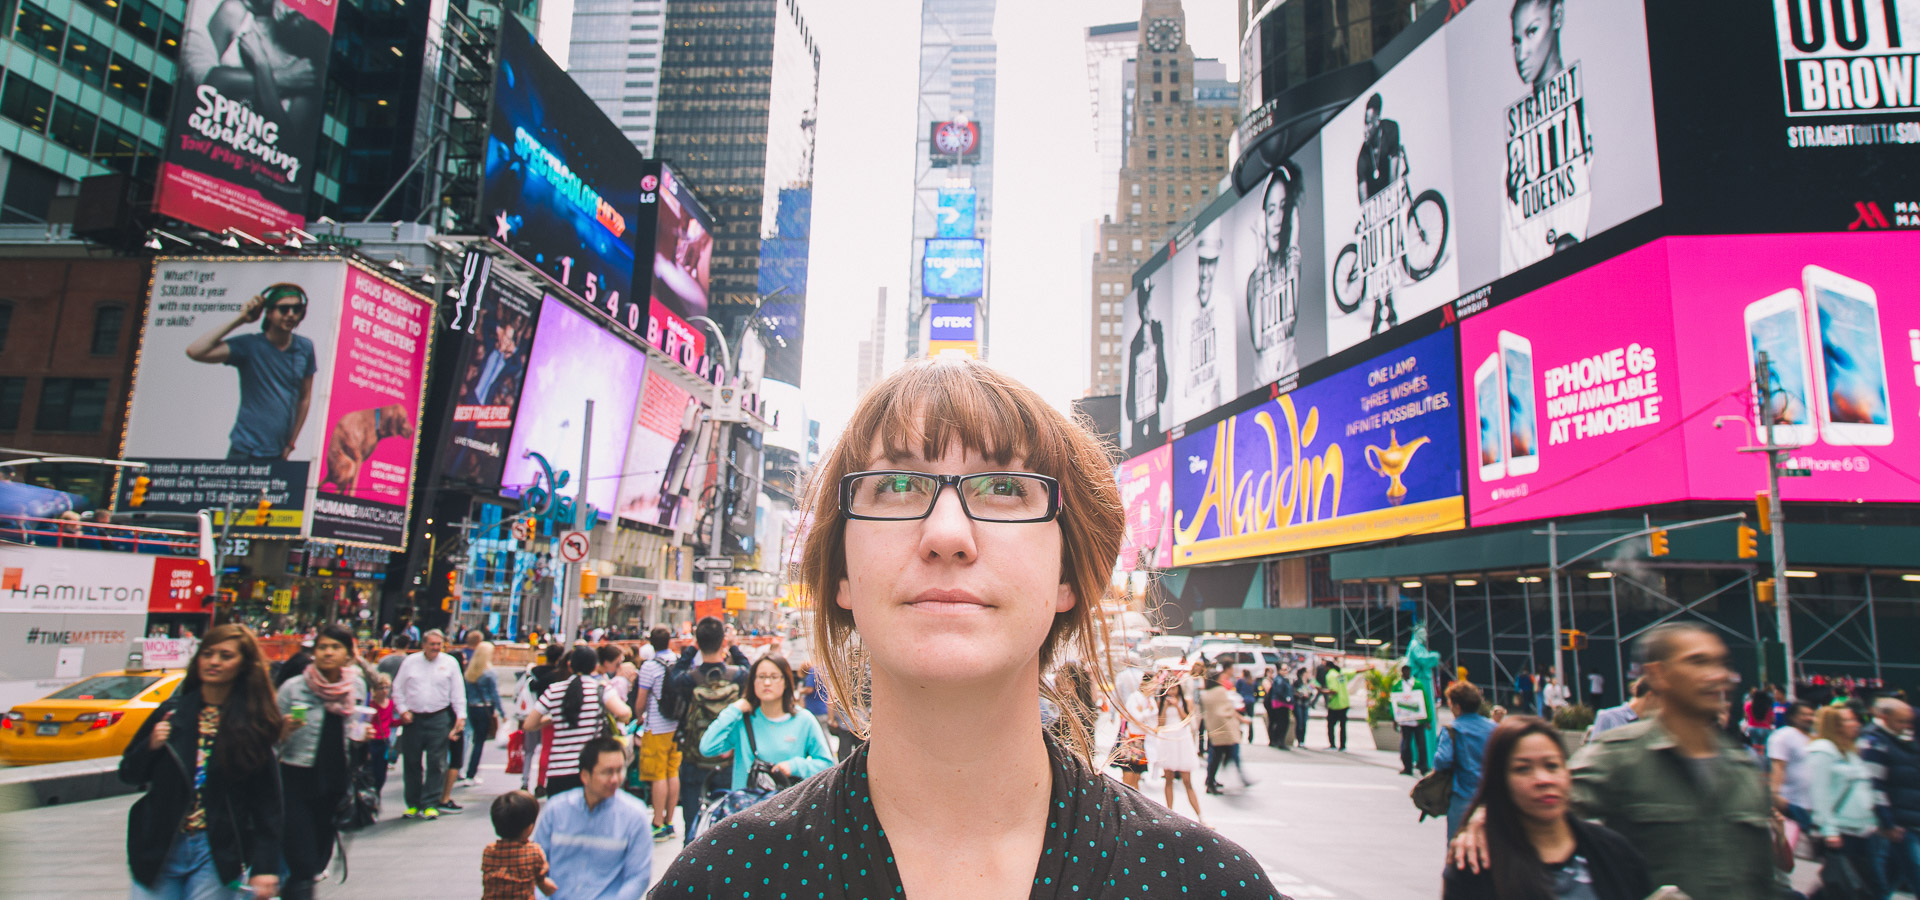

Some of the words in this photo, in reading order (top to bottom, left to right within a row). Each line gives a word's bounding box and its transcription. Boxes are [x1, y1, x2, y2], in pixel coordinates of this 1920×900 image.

[1508, 66, 1577, 138] STRAIGHT
[196, 84, 279, 145] SPRING
[188, 113, 301, 183] awakening
[640, 192, 657, 204] LG
[1522, 164, 1576, 220] QUEENS
[926, 257, 982, 269] TOSHIBA
[164, 270, 194, 282] What?
[199, 271, 215, 284] get
[161, 285, 198, 297] $30,000
[207, 287, 228, 299] year
[355, 274, 382, 300] HSUS
[158, 301, 177, 312] with
[179, 304, 191, 312] no
[192, 303, 243, 314] experience
[351, 294, 377, 318] GIVE
[376, 305, 408, 331] SQUAT
[408, 321, 422, 337] TO
[155, 317, 165, 327] or
[166, 315, 195, 327] skills?
[944, 316, 973, 329] TDK
[352, 315, 373, 336] PET
[372, 324, 417, 354] SHELTERS
[1368, 367, 1389, 387] ONE
[1361, 389, 1390, 412] THREE
[1547, 392, 1579, 420] NOW
[1578, 372, 1658, 408] AVAILABLE
[454, 405, 474, 421] BEST
[473, 405, 491, 421] TIME
[1345, 413, 1382, 437] INFINITE
[1549, 418, 1571, 446] AT
[151, 463, 178, 474] needs
[180, 466, 191, 474] an
[192, 463, 237, 475] education
[238, 466, 249, 475] or
[250, 464, 271, 476] hard
[1174, 394, 1344, 546] Aladdin
[1800, 456, 1842, 472] iPhone
[152, 478, 175, 489] when
[229, 478, 238, 488] is
[239, 479, 270, 492] raising
[272, 479, 287, 491] the
[167, 492, 191, 504] wage
[193, 492, 205, 502] to
[206, 492, 215, 502] 15
[171, 569, 194, 579] OPEN
[170, 578, 192, 588] LOOP
[11, 584, 145, 602] HAMILTON
[27, 628, 126, 645] #TIMEMATTERS
